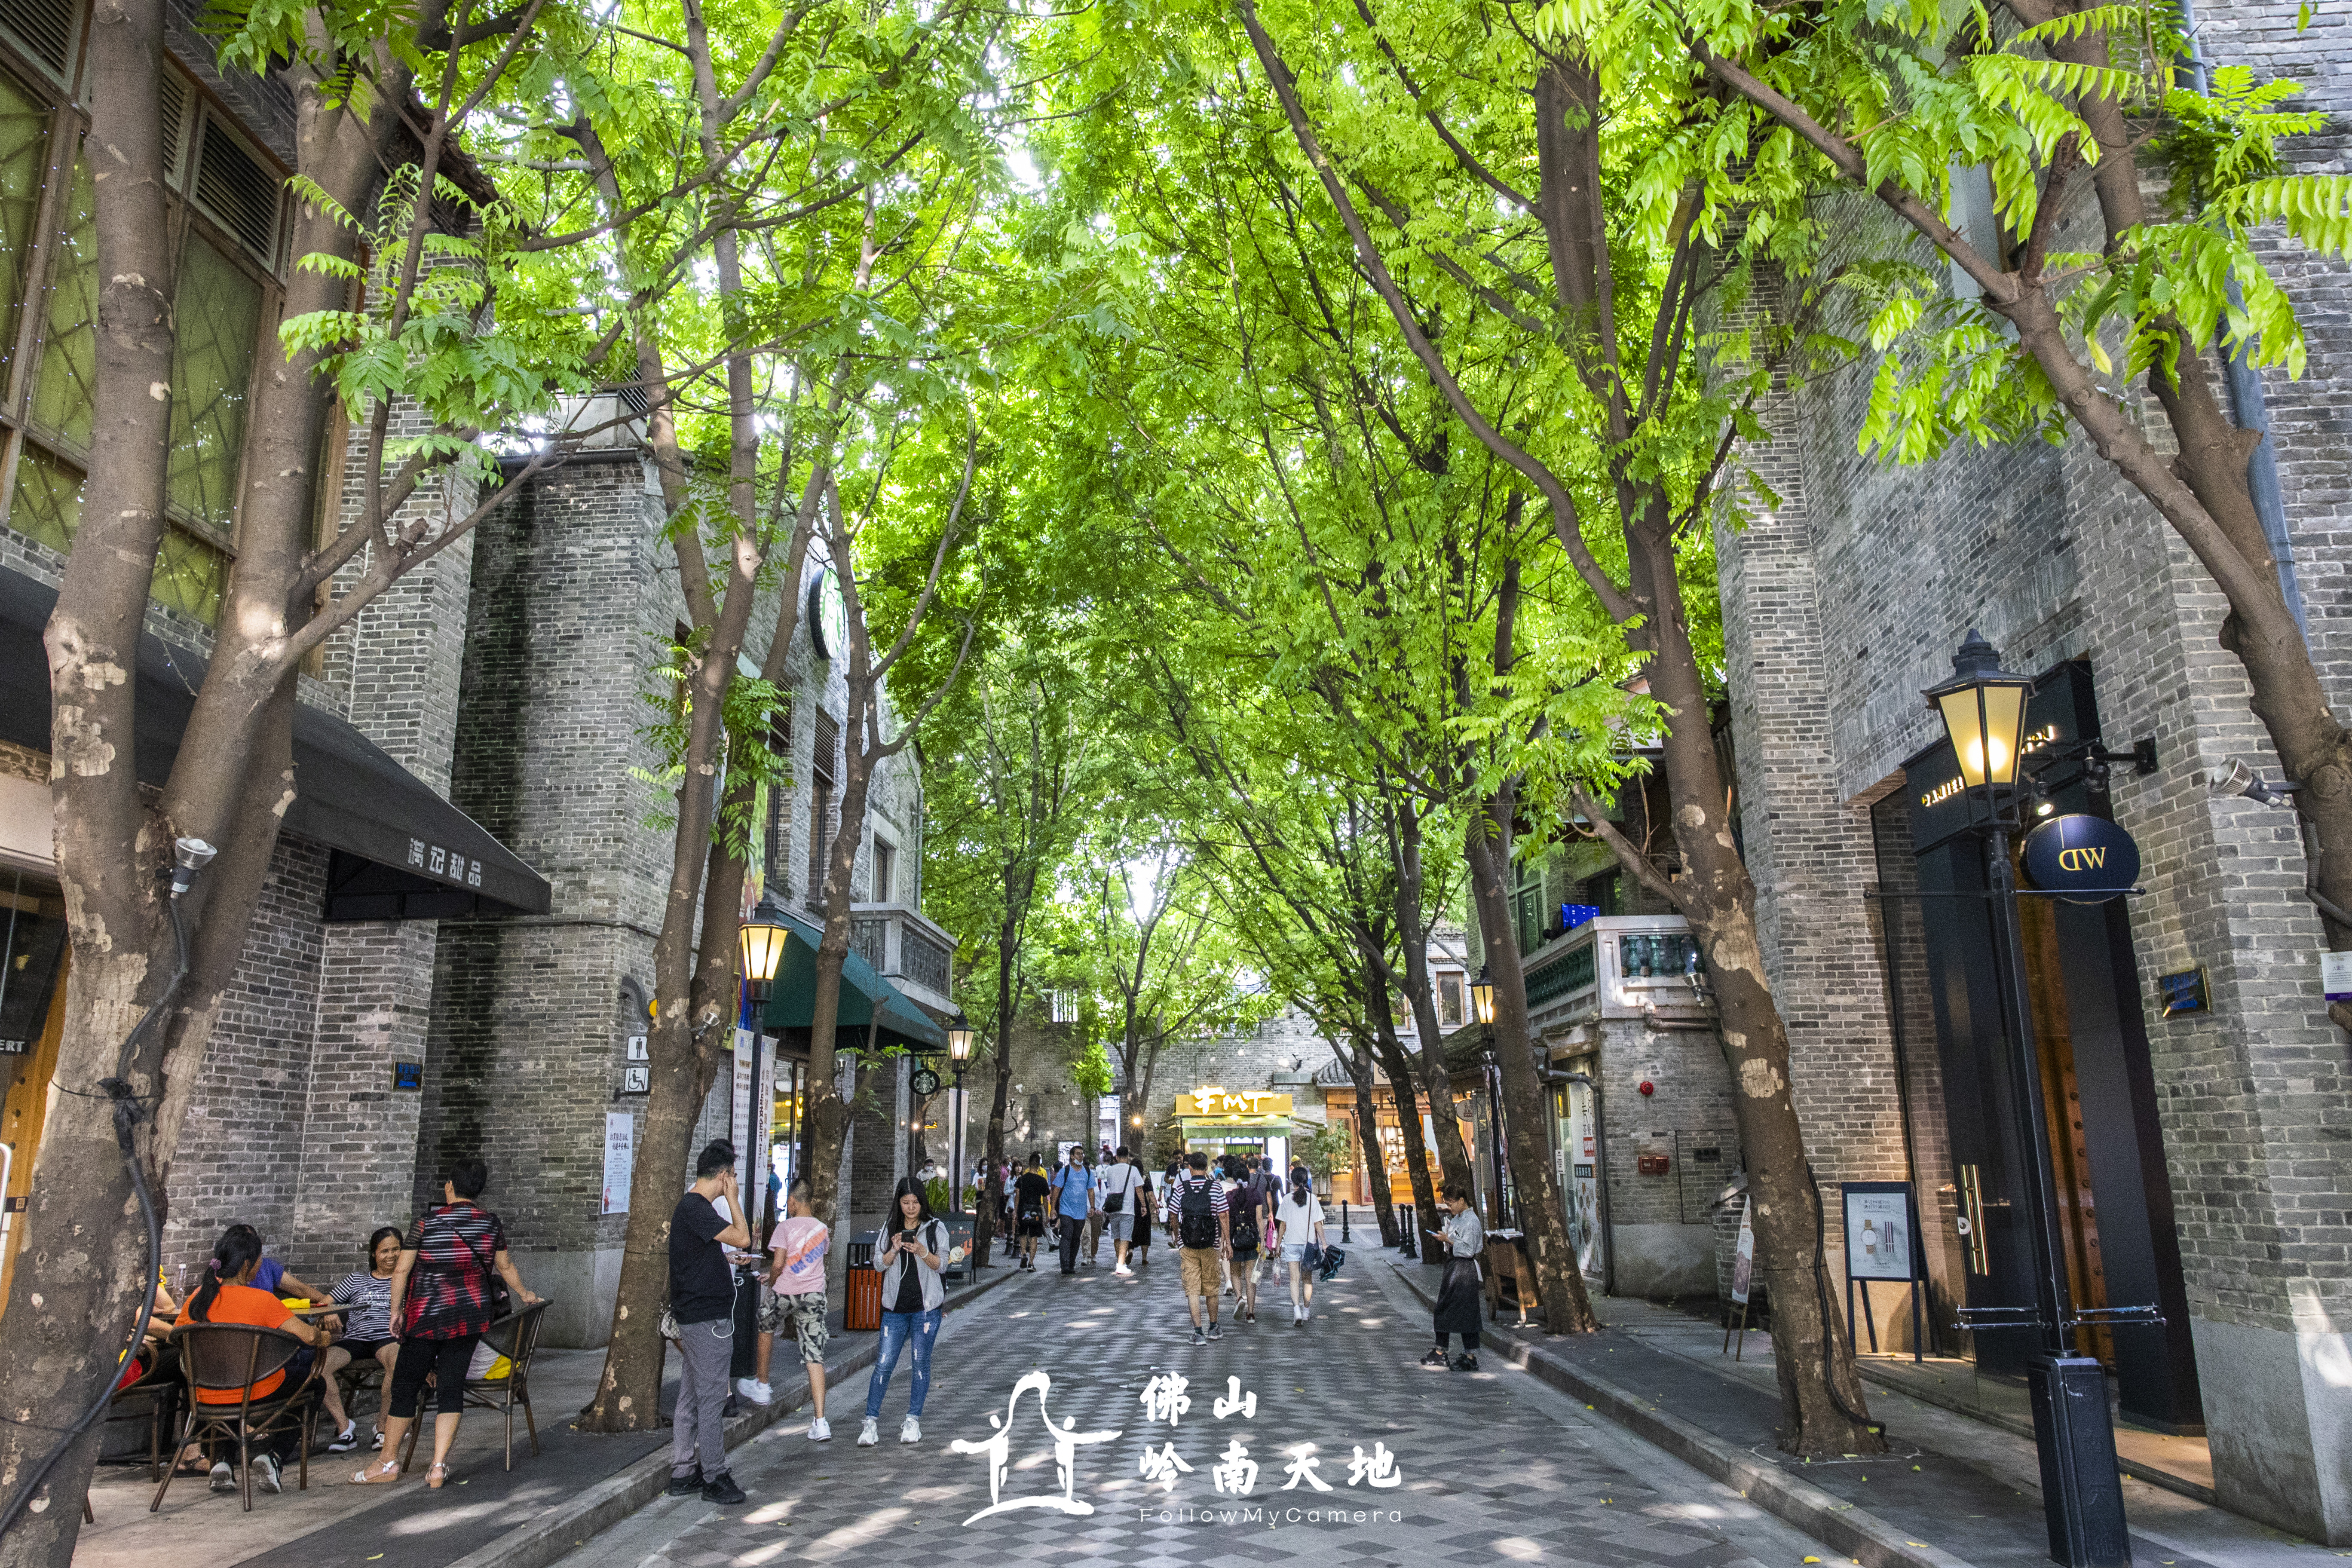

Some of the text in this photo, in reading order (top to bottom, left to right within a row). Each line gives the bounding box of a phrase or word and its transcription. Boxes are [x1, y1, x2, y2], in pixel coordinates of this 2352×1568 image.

[408, 837, 482, 887] 满记甜品
[1194, 1084, 1274, 1114] FMT
